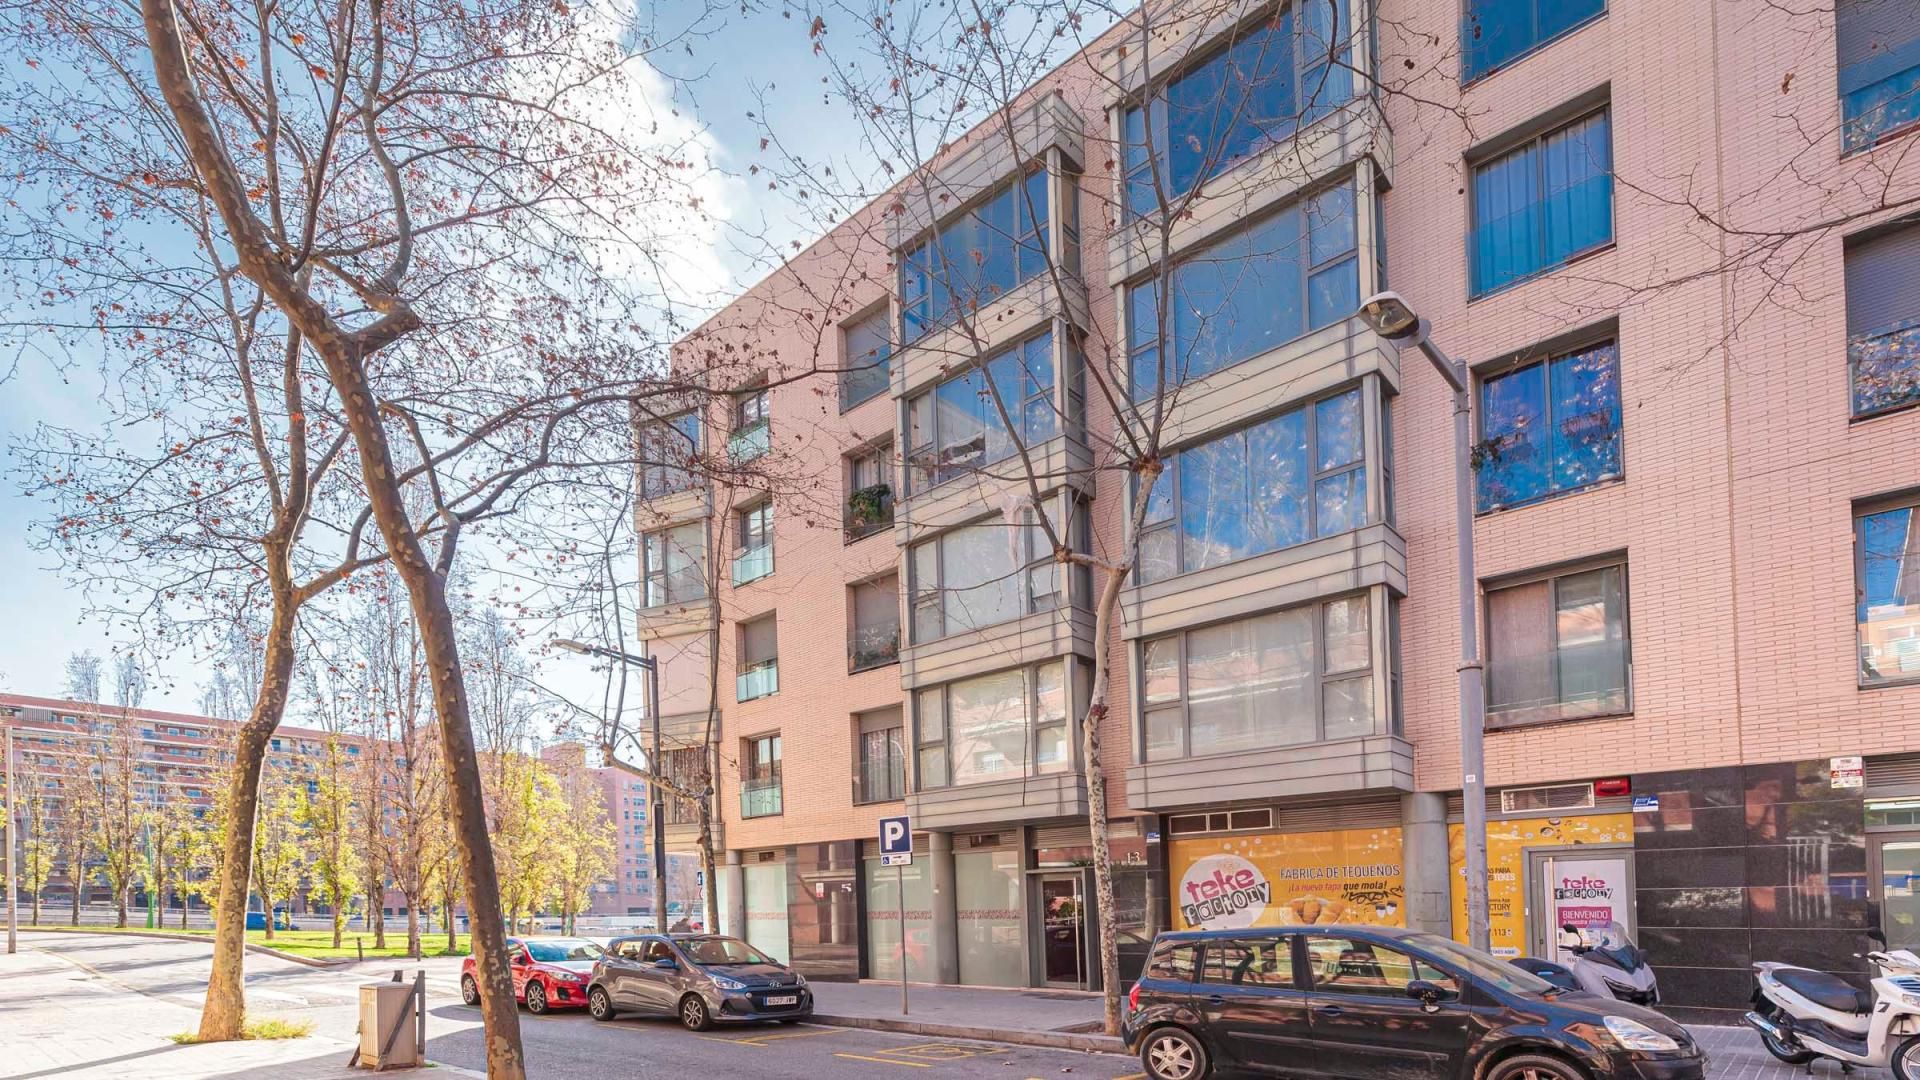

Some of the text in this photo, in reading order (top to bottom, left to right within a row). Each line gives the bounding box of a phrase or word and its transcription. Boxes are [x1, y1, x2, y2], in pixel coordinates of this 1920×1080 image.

[885, 821, 904, 850] P
[1326, 867, 1339, 879] DE
[1186, 869, 1255, 903] teke
[1343, 883, 1359, 891] que
[1361, 881, 1387, 890] mola!
[1562, 876, 1606, 889] teke
[1562, 910, 1608, 919] BIENVENIDO
